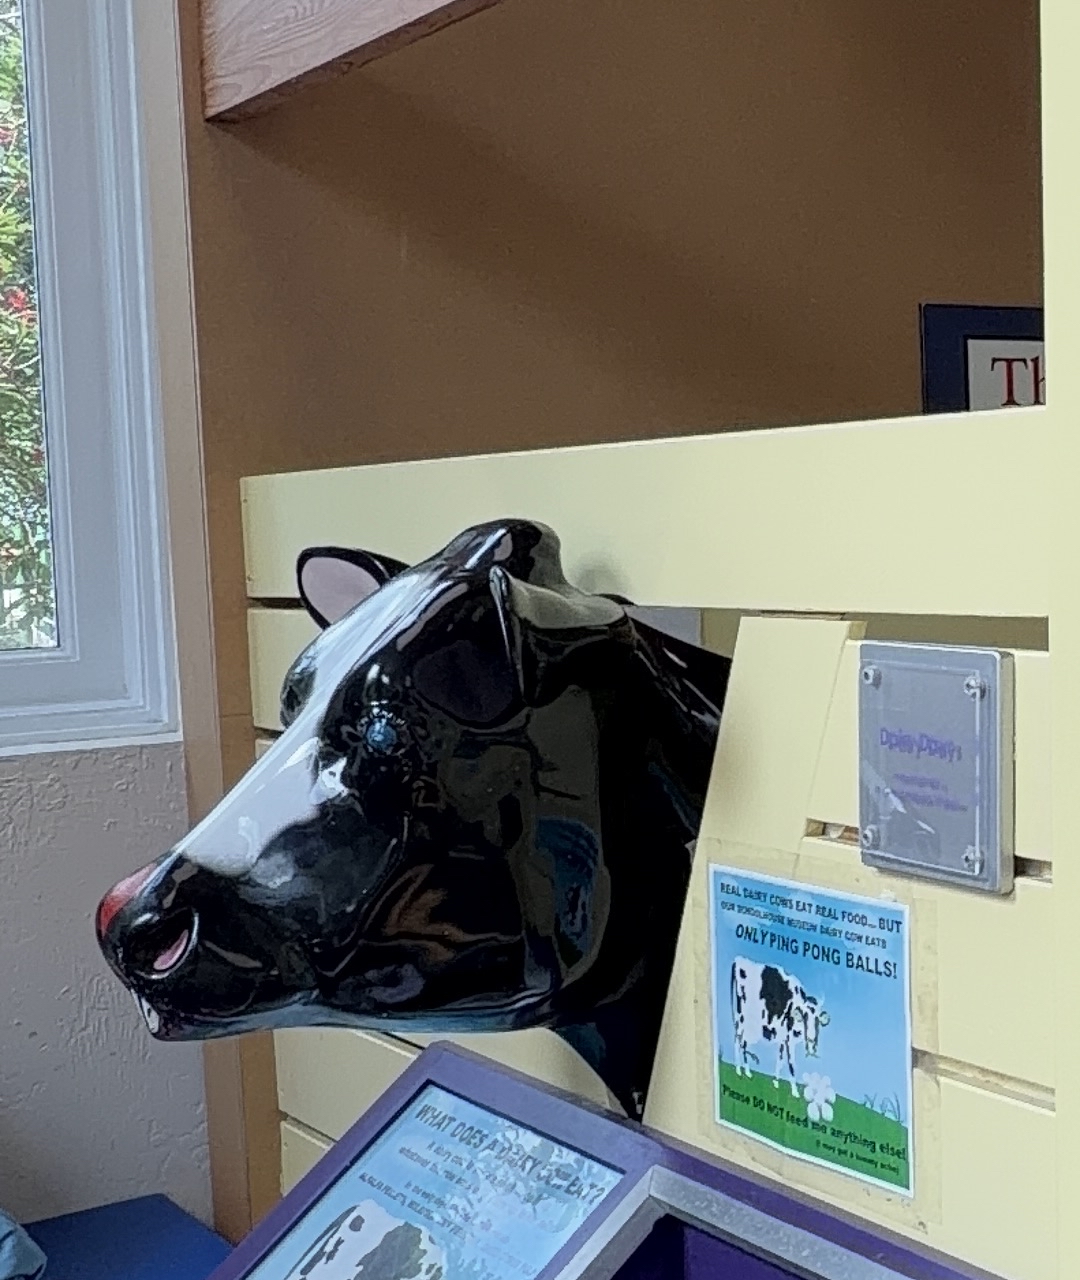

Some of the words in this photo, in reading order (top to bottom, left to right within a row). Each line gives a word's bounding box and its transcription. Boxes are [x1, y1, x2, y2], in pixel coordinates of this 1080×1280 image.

[720, 882, 740, 897] REAL
[743, 887, 767, 904] DAIRY
[769, 893, 793, 910] COWS
[795, 899, 812, 914] EAT
[815, 904, 838, 920] REAL
[878, 916, 902, 934] BUT
[735, 923, 769, 947] ONLY
[769, 932, 798, 955] PING
[802, 940, 840, 965] PONG
[846, 951, 896, 980] BALLS!
[820, 925, 842, 939] DAIRY
[844, 930, 862, 944] COW
[865, 935, 886, 949] EATS
[722, 1084, 750, 1105] Please
[752, 1095, 764, 1110] DO
[767, 1102, 784, 1119] NOT
[786, 1110, 809, 1128] feed
[811, 1121, 827, 1134] me
[830, 1128, 876, 1153] anything
[879, 1141, 906, 1160] else!
[415, 1104, 456, 1132] WHAT
[450, 1122, 489, 1148] DOES
[481, 1138, 499, 1152] A
[495, 1143, 542, 1175] DAIRY
[564, 1176, 606, 1206] EAT?
